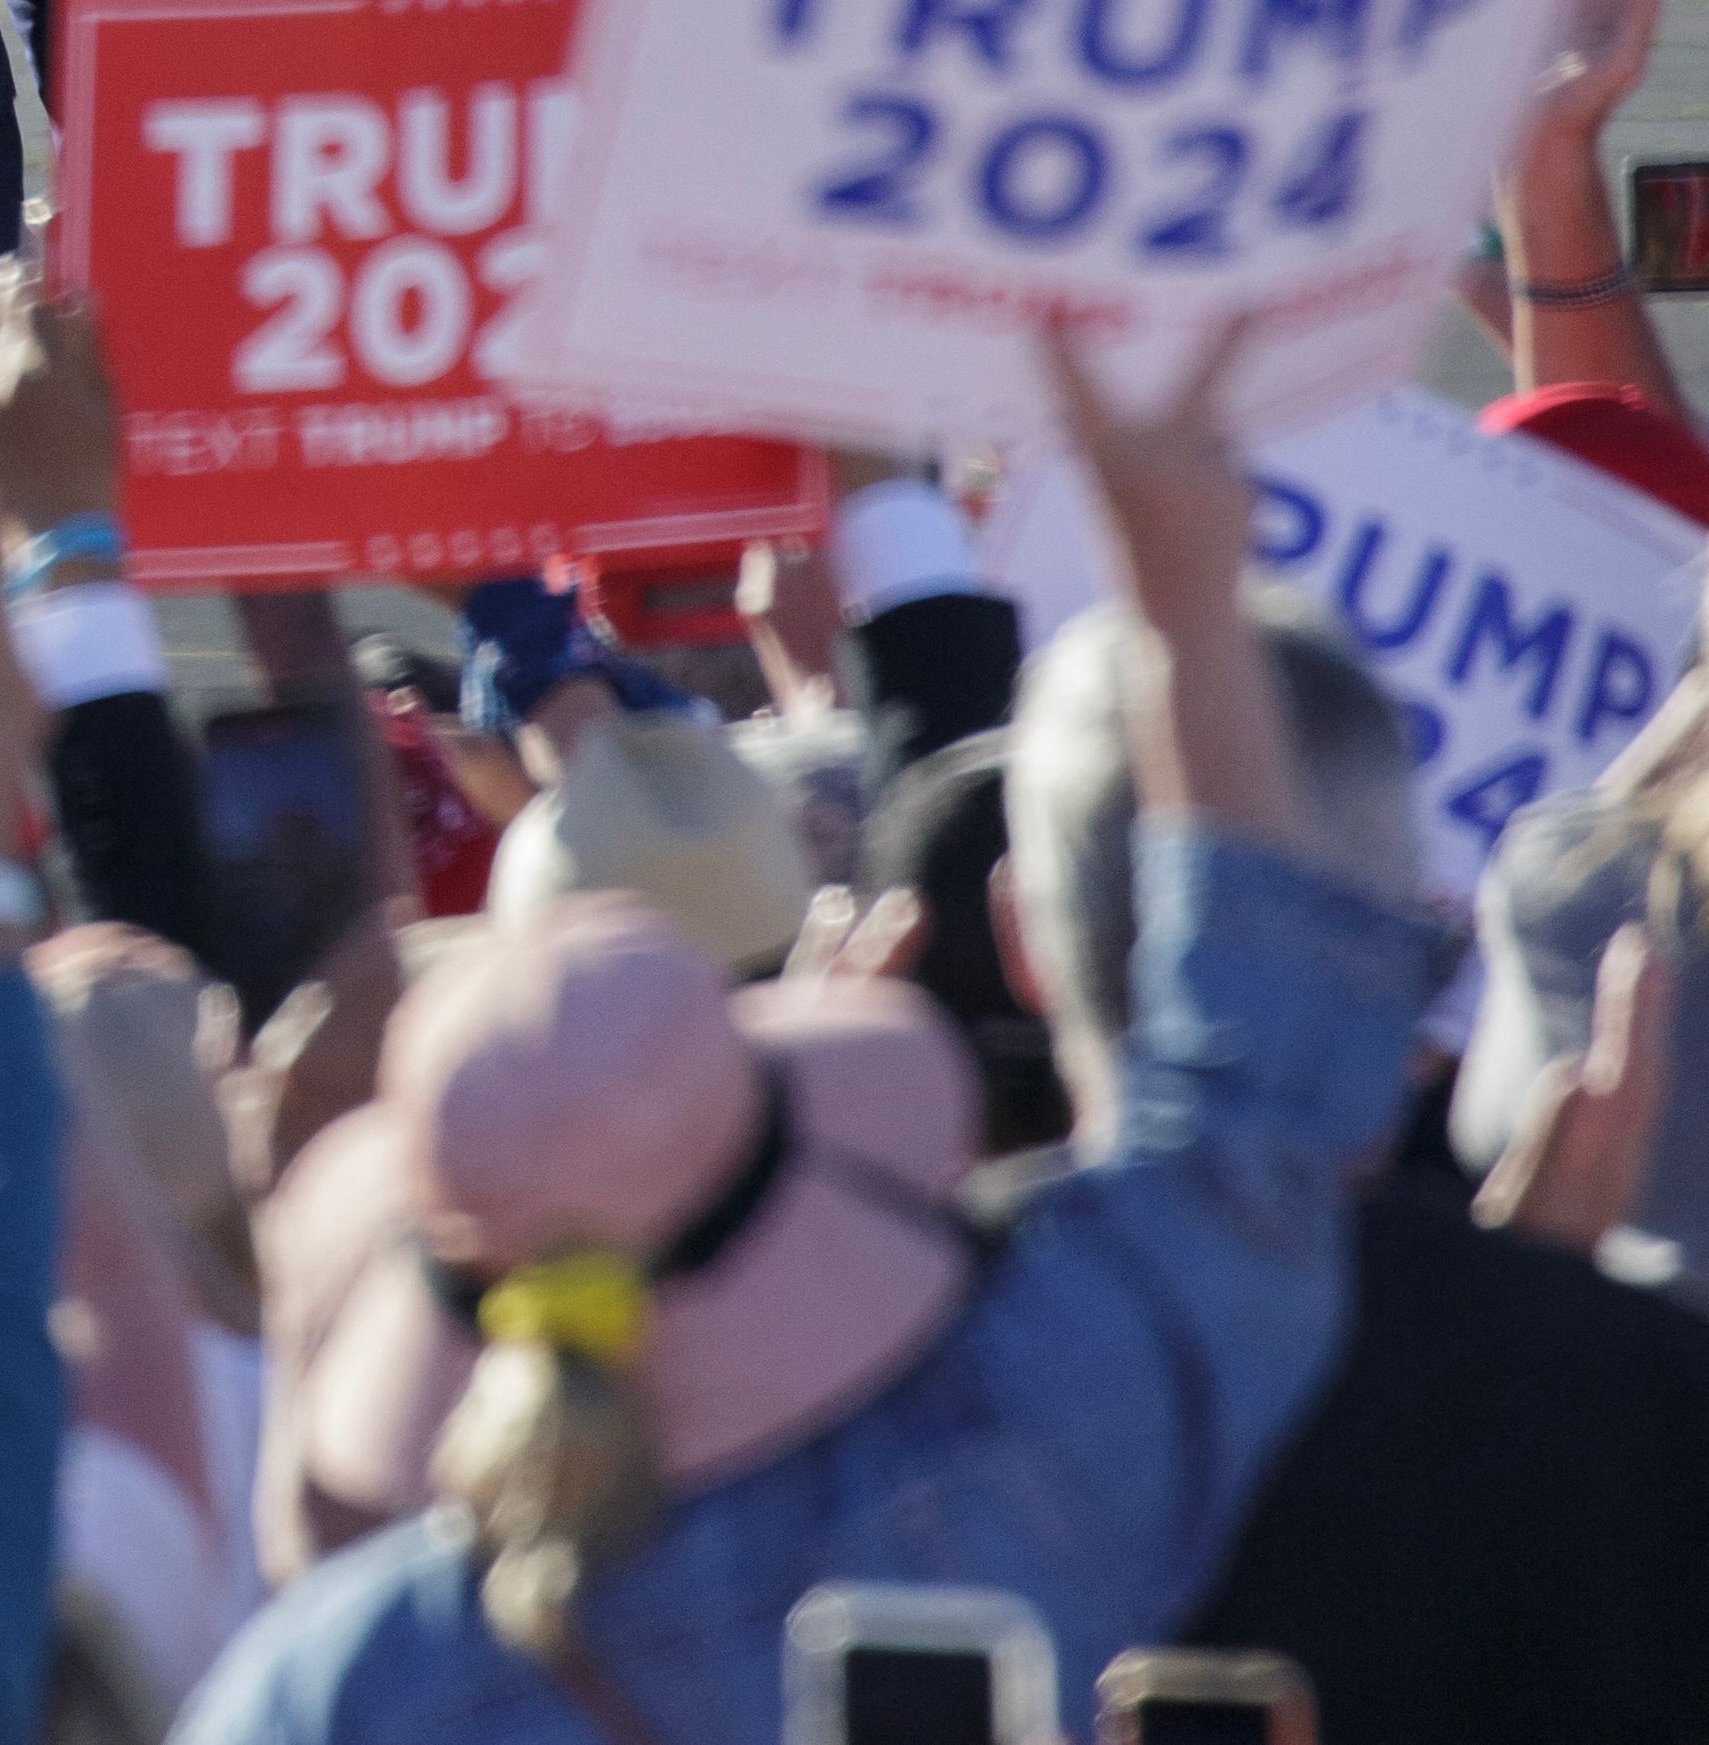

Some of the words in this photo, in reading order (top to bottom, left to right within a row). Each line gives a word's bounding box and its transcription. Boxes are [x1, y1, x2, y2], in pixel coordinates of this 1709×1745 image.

[142, 82, 574, 247] TRU
[812, 88, 1376, 261] 2024
[230, 234, 554, 395] 202
